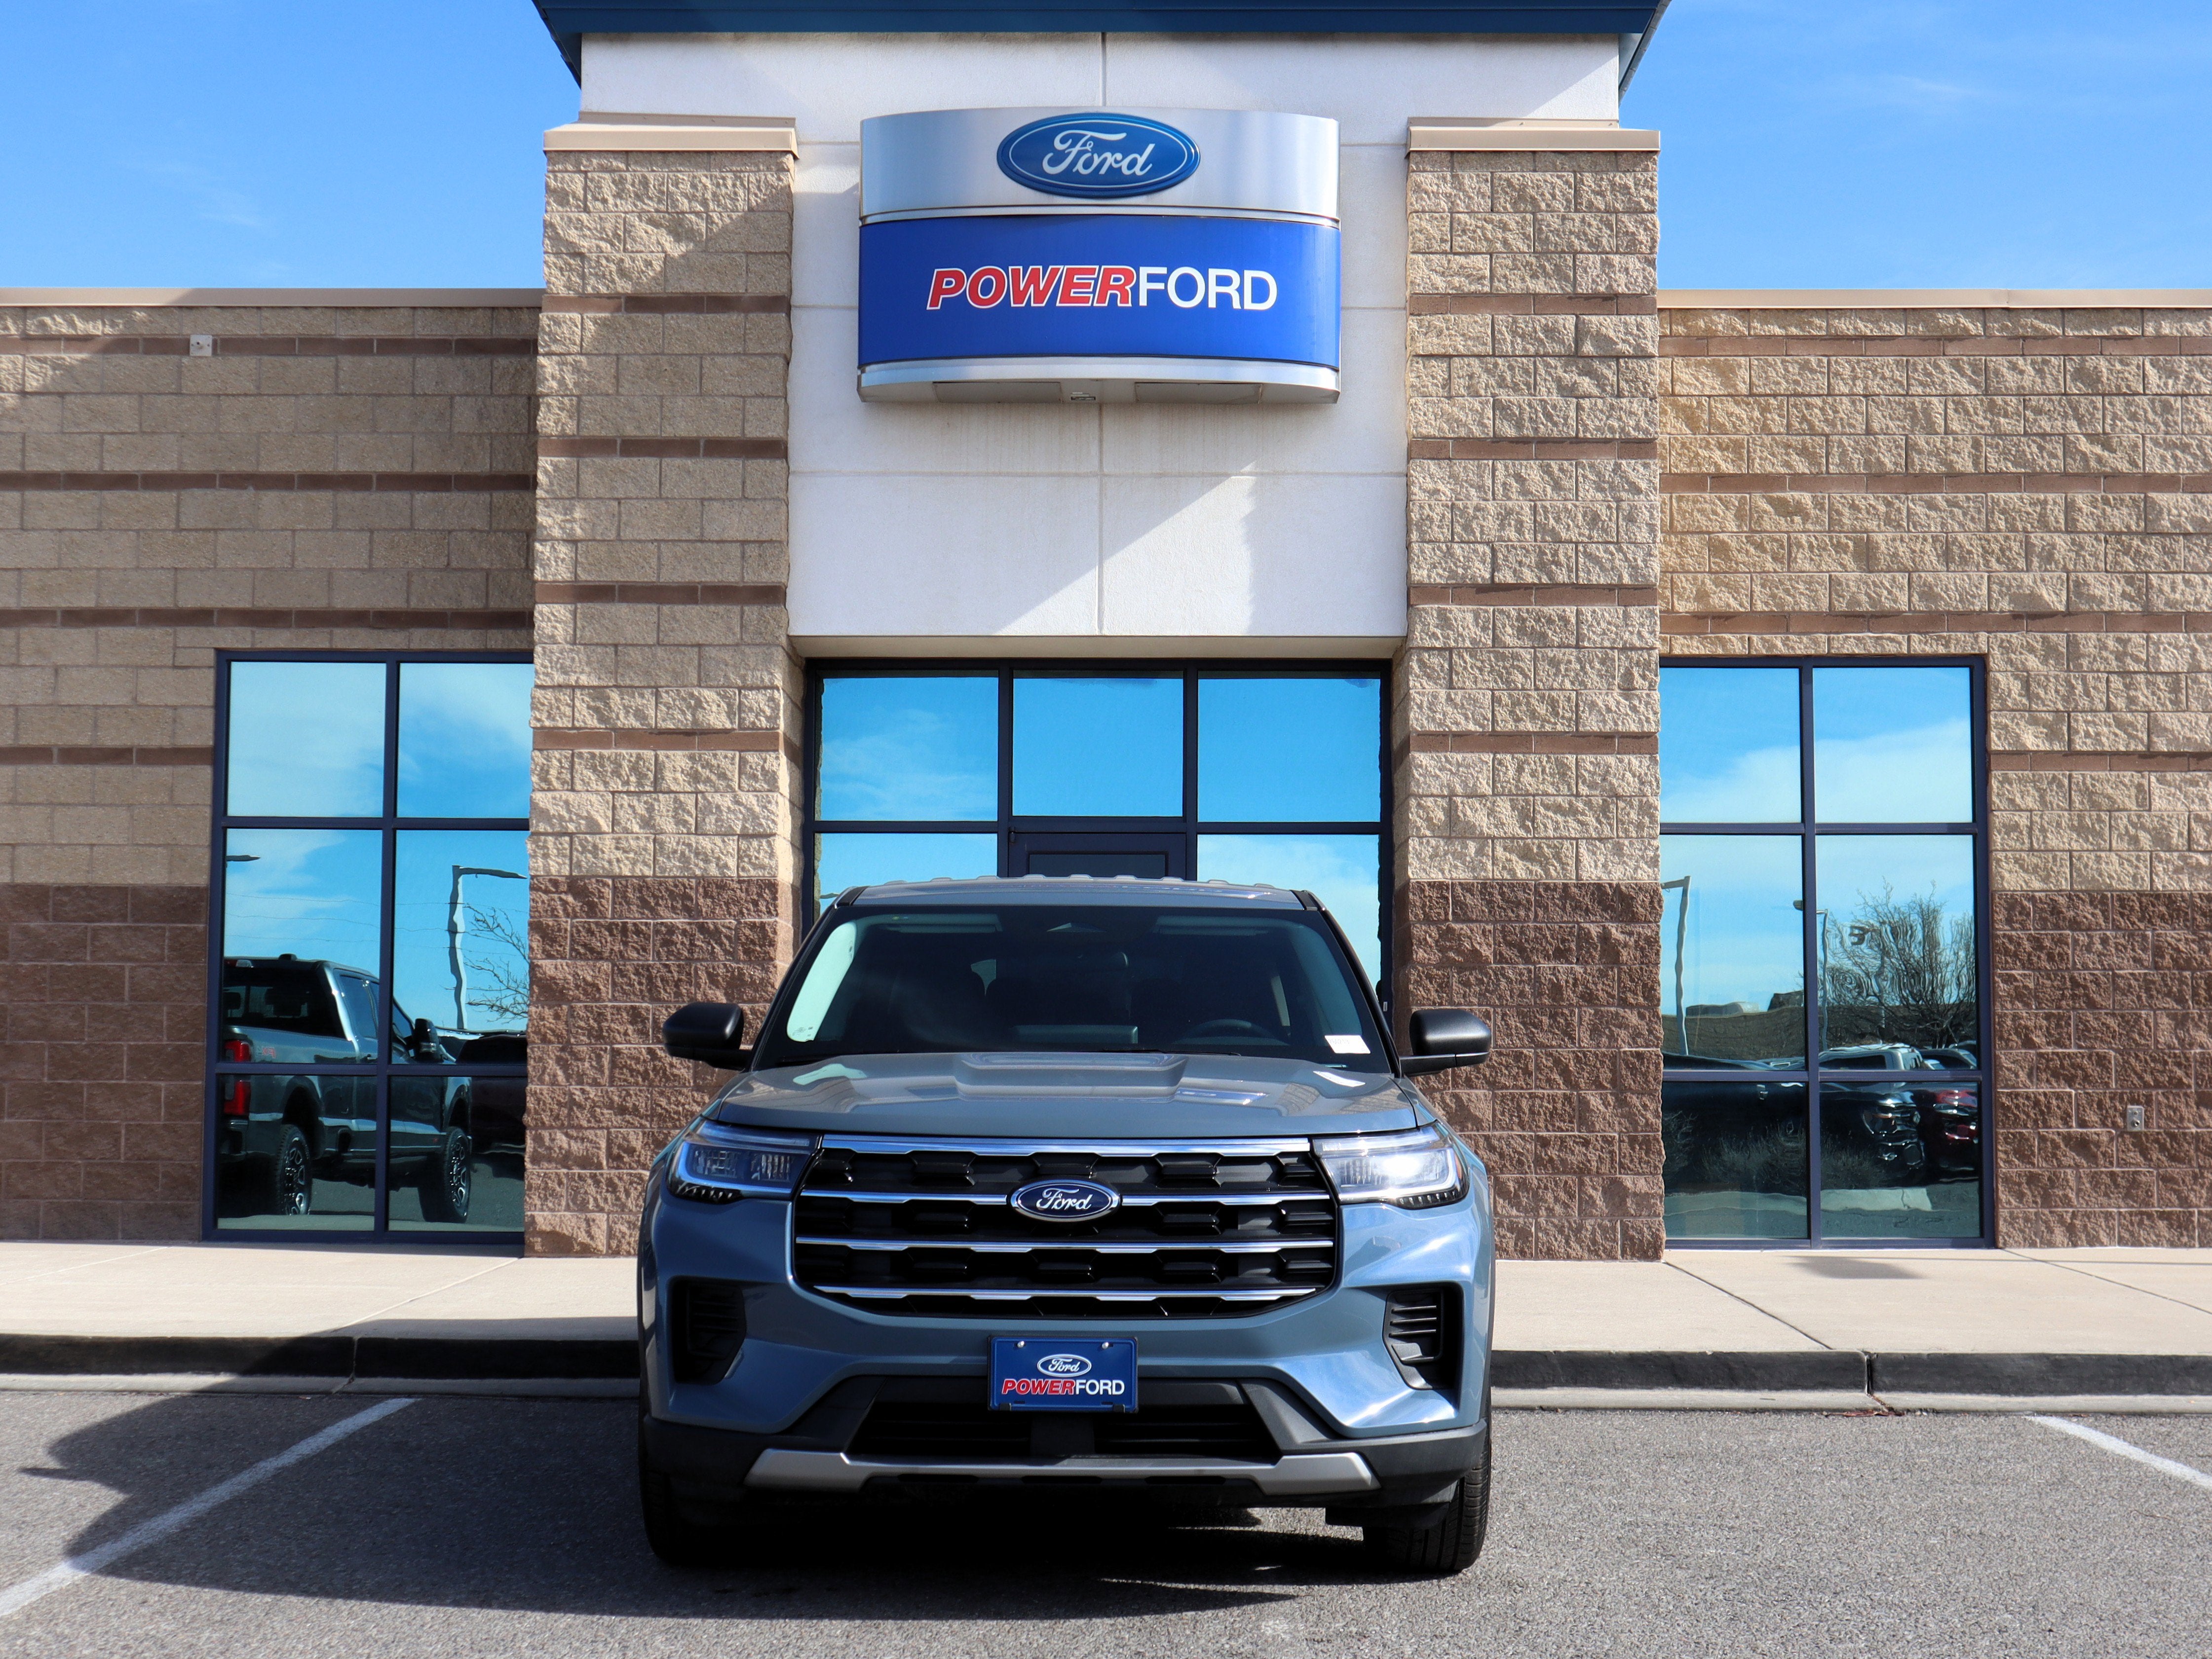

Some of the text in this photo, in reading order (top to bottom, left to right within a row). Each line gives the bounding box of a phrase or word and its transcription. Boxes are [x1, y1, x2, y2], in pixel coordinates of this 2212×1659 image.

[1042, 129, 1155, 176] Ford
[1036, 1187, 1093, 1210] Ford
[1048, 1358, 1080, 1372] Ford
